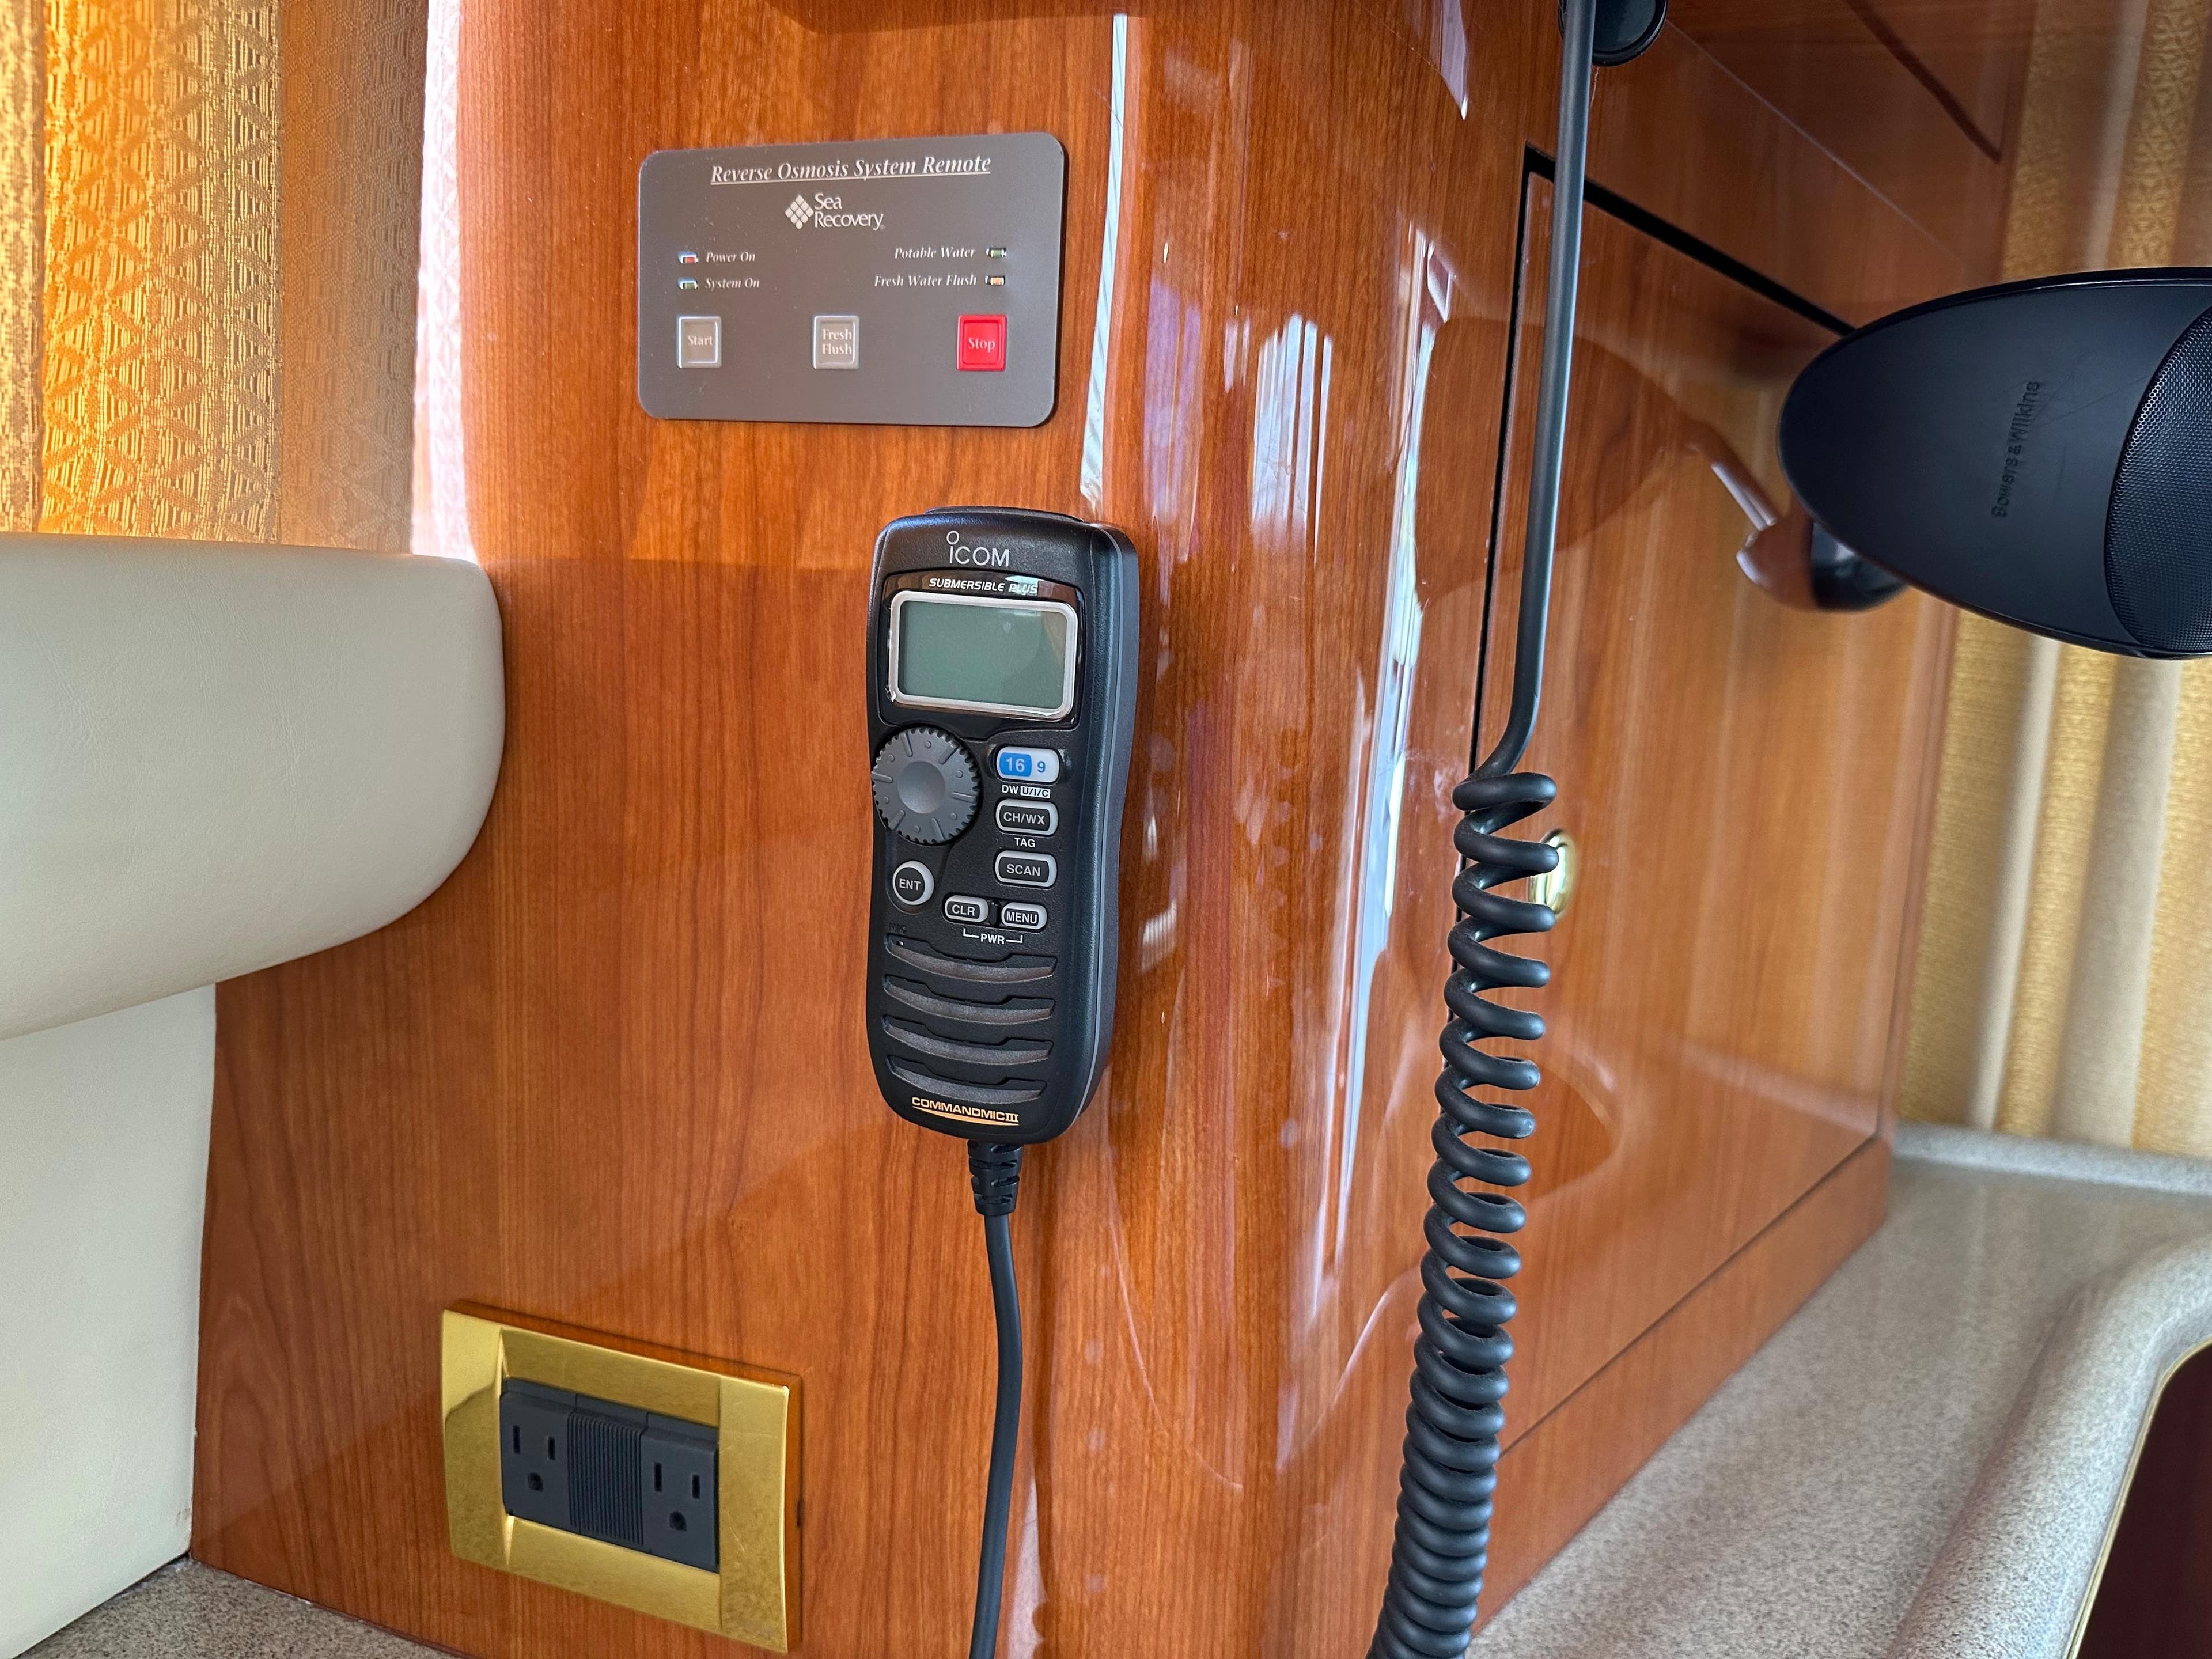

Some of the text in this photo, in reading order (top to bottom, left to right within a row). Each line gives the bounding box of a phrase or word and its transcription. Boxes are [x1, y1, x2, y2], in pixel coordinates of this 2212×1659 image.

[711, 155, 991, 183] Reverse Osmosis System Remote
[814, 192, 843, 210] Sea
[814, 211, 884, 231] Recovery
[706, 251, 756, 263] Power On
[894, 246, 976, 259] Potable Water
[705, 277, 760, 291] System On
[874, 274, 978, 287] Fresh Water Flush
[823, 328, 853, 341] Fresh
[687, 335, 714, 348] Start
[967, 336, 996, 353] Stop
[822, 342, 853, 355] Flush
[1991, 456, 2018, 517] Bowers
[929, 577, 1038, 595] SUBMERSIBLE PLUS
[1005, 757, 1046, 773] 16 9
[1001, 785, 1050, 798] DW U/I/C
[1003, 811, 1046, 825] CH/WX
[1014, 837, 1036, 848] TAG
[1006, 863, 1041, 877] SCAN
[899, 878, 921, 891] ENT
[951, 904, 975, 916] CLR
[1005, 911, 1037, 924] MENU
[980, 933, 1005, 945] PWR
